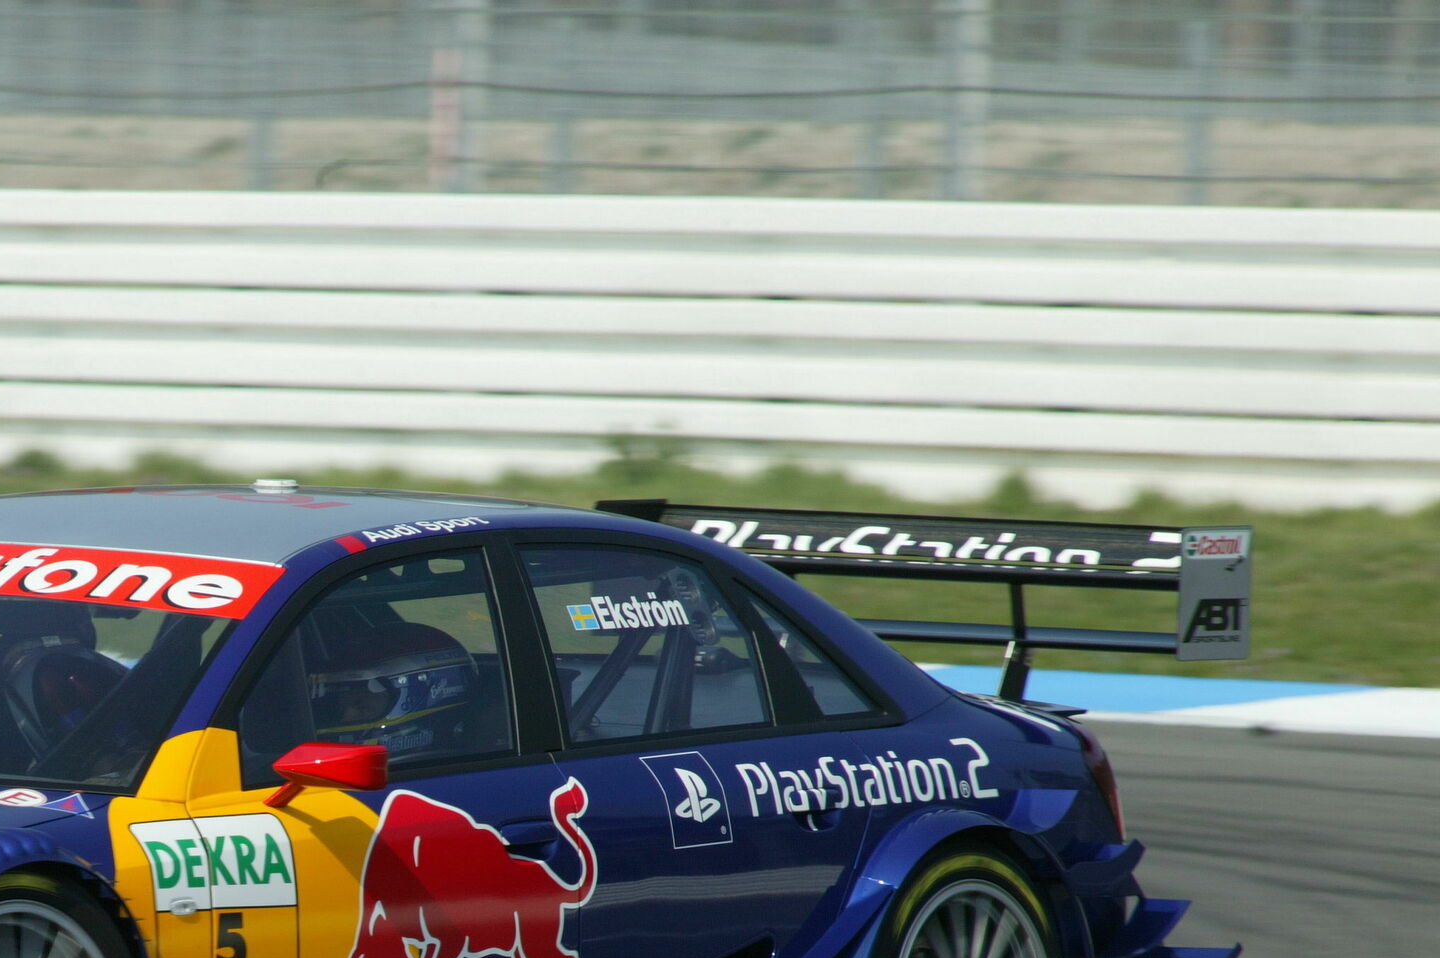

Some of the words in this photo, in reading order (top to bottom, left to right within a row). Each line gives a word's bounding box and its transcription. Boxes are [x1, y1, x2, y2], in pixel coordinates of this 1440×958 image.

[362, 523, 421, 543] Audi
[415, 515, 490, 533] Sport
[1199, 535, 1243, 556] Castrol
[590, 591, 690, 630] Ekström
[1182, 598, 1247, 643] ABT
[144, 832, 293, 889] DEKRA
